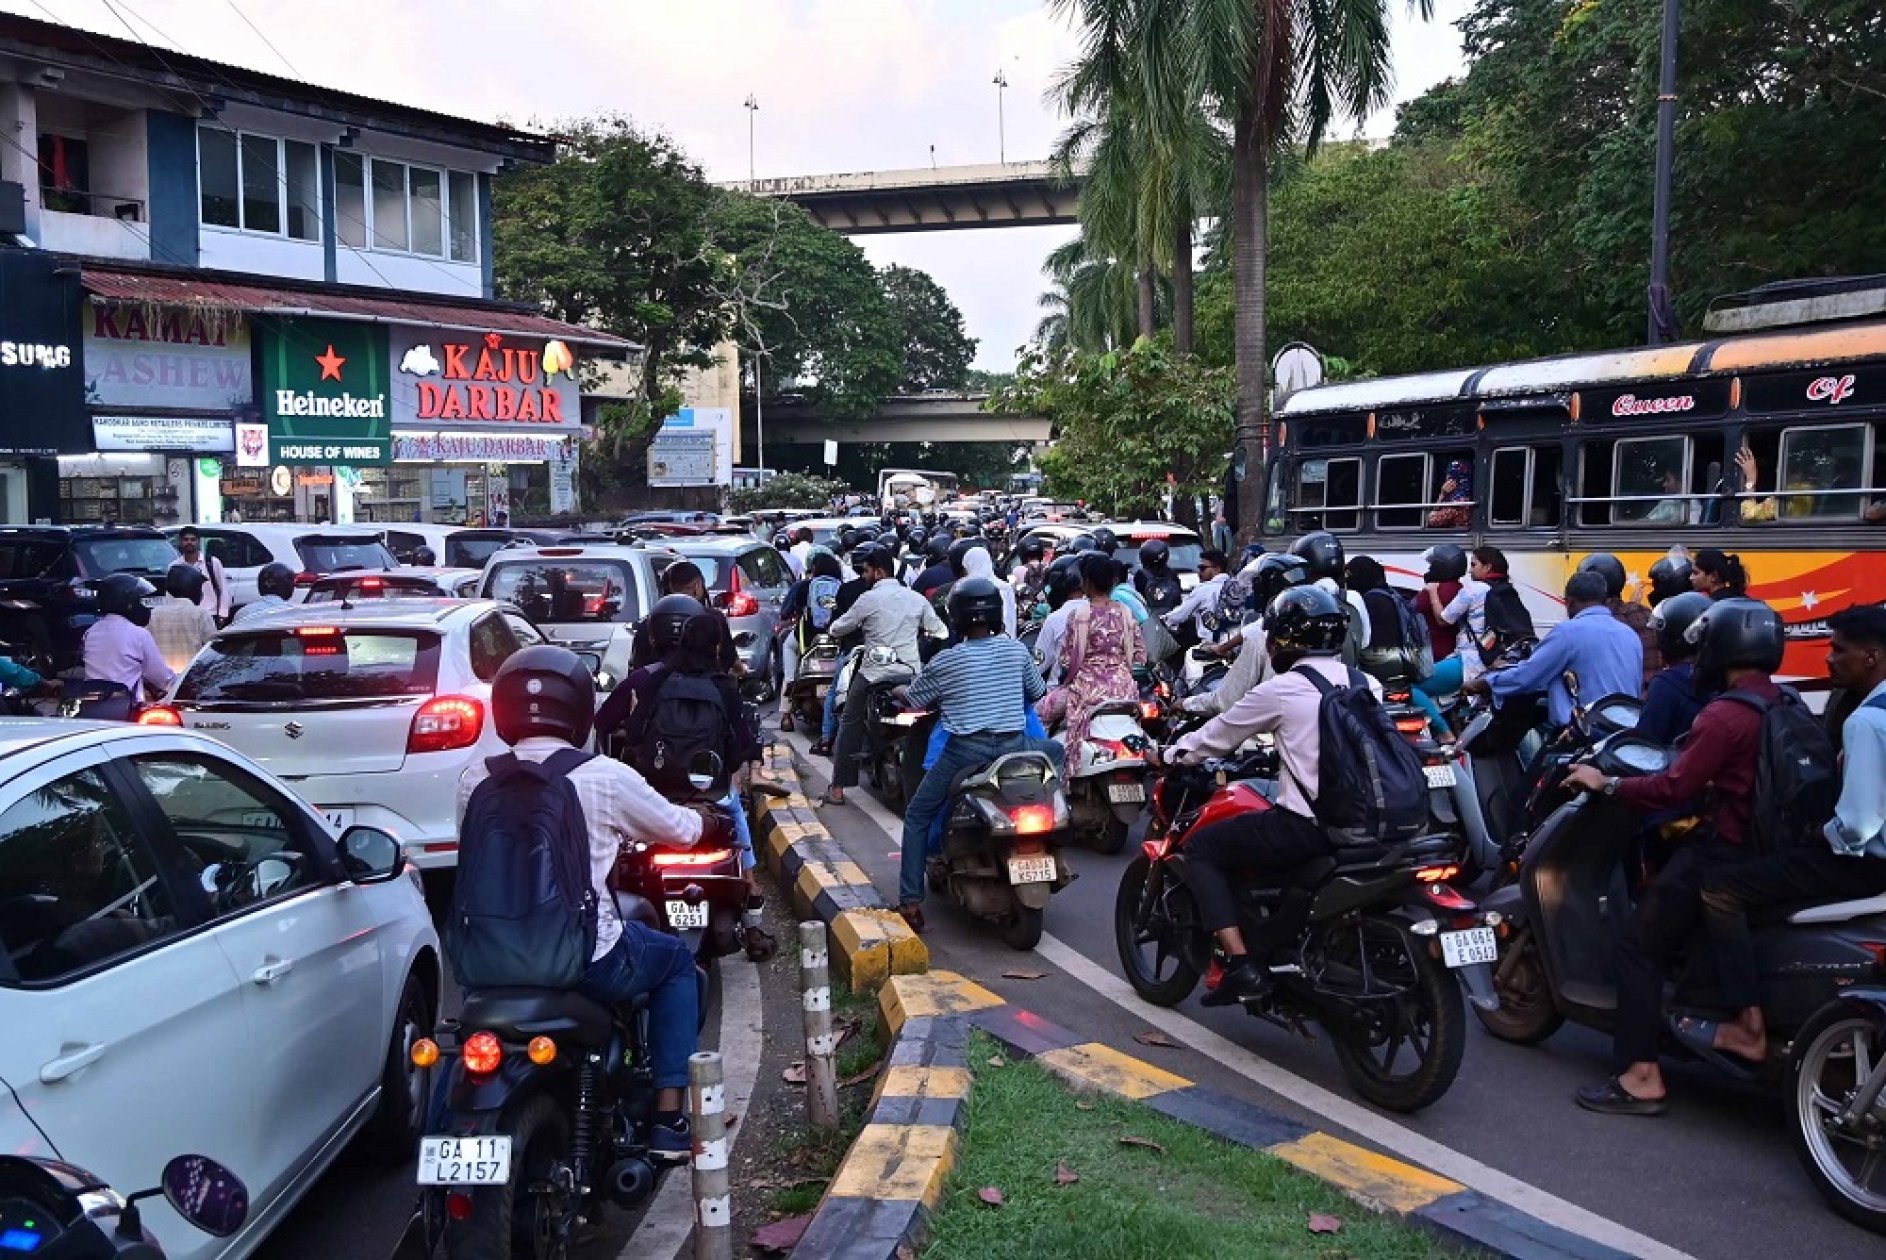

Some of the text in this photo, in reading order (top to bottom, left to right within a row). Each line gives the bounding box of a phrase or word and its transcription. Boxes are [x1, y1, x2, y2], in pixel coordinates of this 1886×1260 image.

[442, 344, 538, 384] KAJU
[1807, 374, 1855, 404] Of
[276, 389, 385, 418] Heineken
[416, 381, 563, 423] DARBAR
[1612, 394, 1695, 416] Queen
[280, 445, 381, 460] HOUSE OF WINES
[440, 1139, 496, 1159] GA 11
[437, 1161, 500, 1181] L2157
